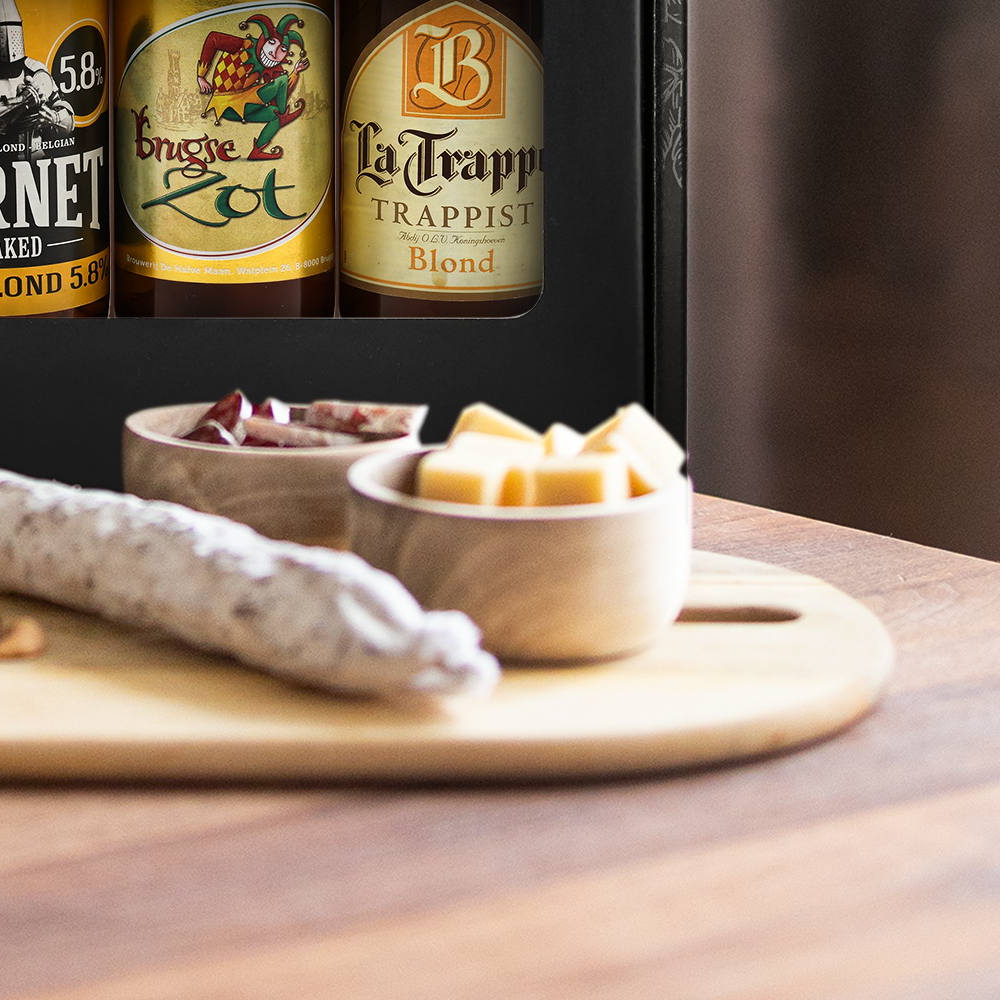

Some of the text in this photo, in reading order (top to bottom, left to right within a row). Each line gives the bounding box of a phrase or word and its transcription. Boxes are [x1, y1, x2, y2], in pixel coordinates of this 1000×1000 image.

[60, 51, 104, 94] 5.8%
[35, 137, 76, 150] BELGIAN
[130, 104, 240, 179] brugse
[350, 120, 401, 194] La
[141, 166, 307, 227] Zot
[371, 197, 535, 229] TRAPPIST
[398, 230, 420, 243] Abdij
[126, 254, 158, 271] Brouwerij
[161, 262, 172, 272] De
[174, 264, 200, 274] Halve
[204, 266, 233, 276] Maan,
[236, 264, 278, 276] Walplein
[295, 257, 320, 270] B-8000
[408, 246, 496, 274] Blond
